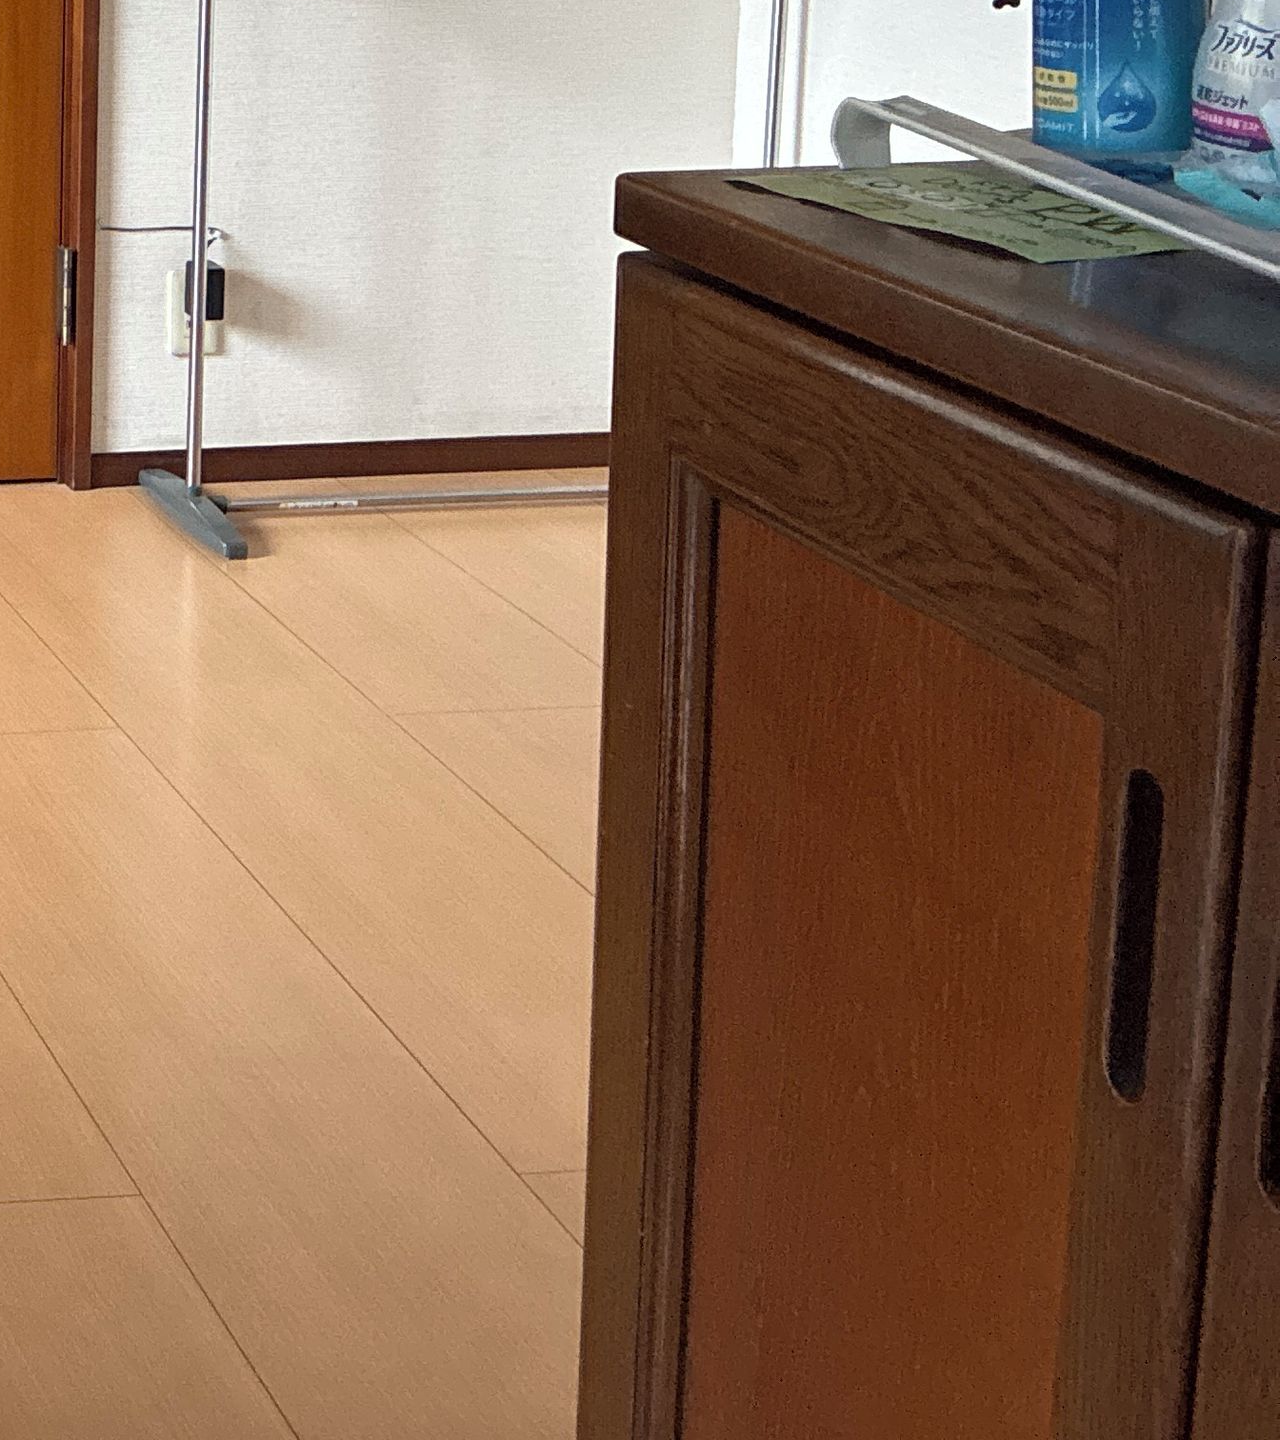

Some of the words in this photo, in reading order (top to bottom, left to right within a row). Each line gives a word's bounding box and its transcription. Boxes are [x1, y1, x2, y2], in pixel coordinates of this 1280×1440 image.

[1211, 24, 1276, 60] ファブリーズ
